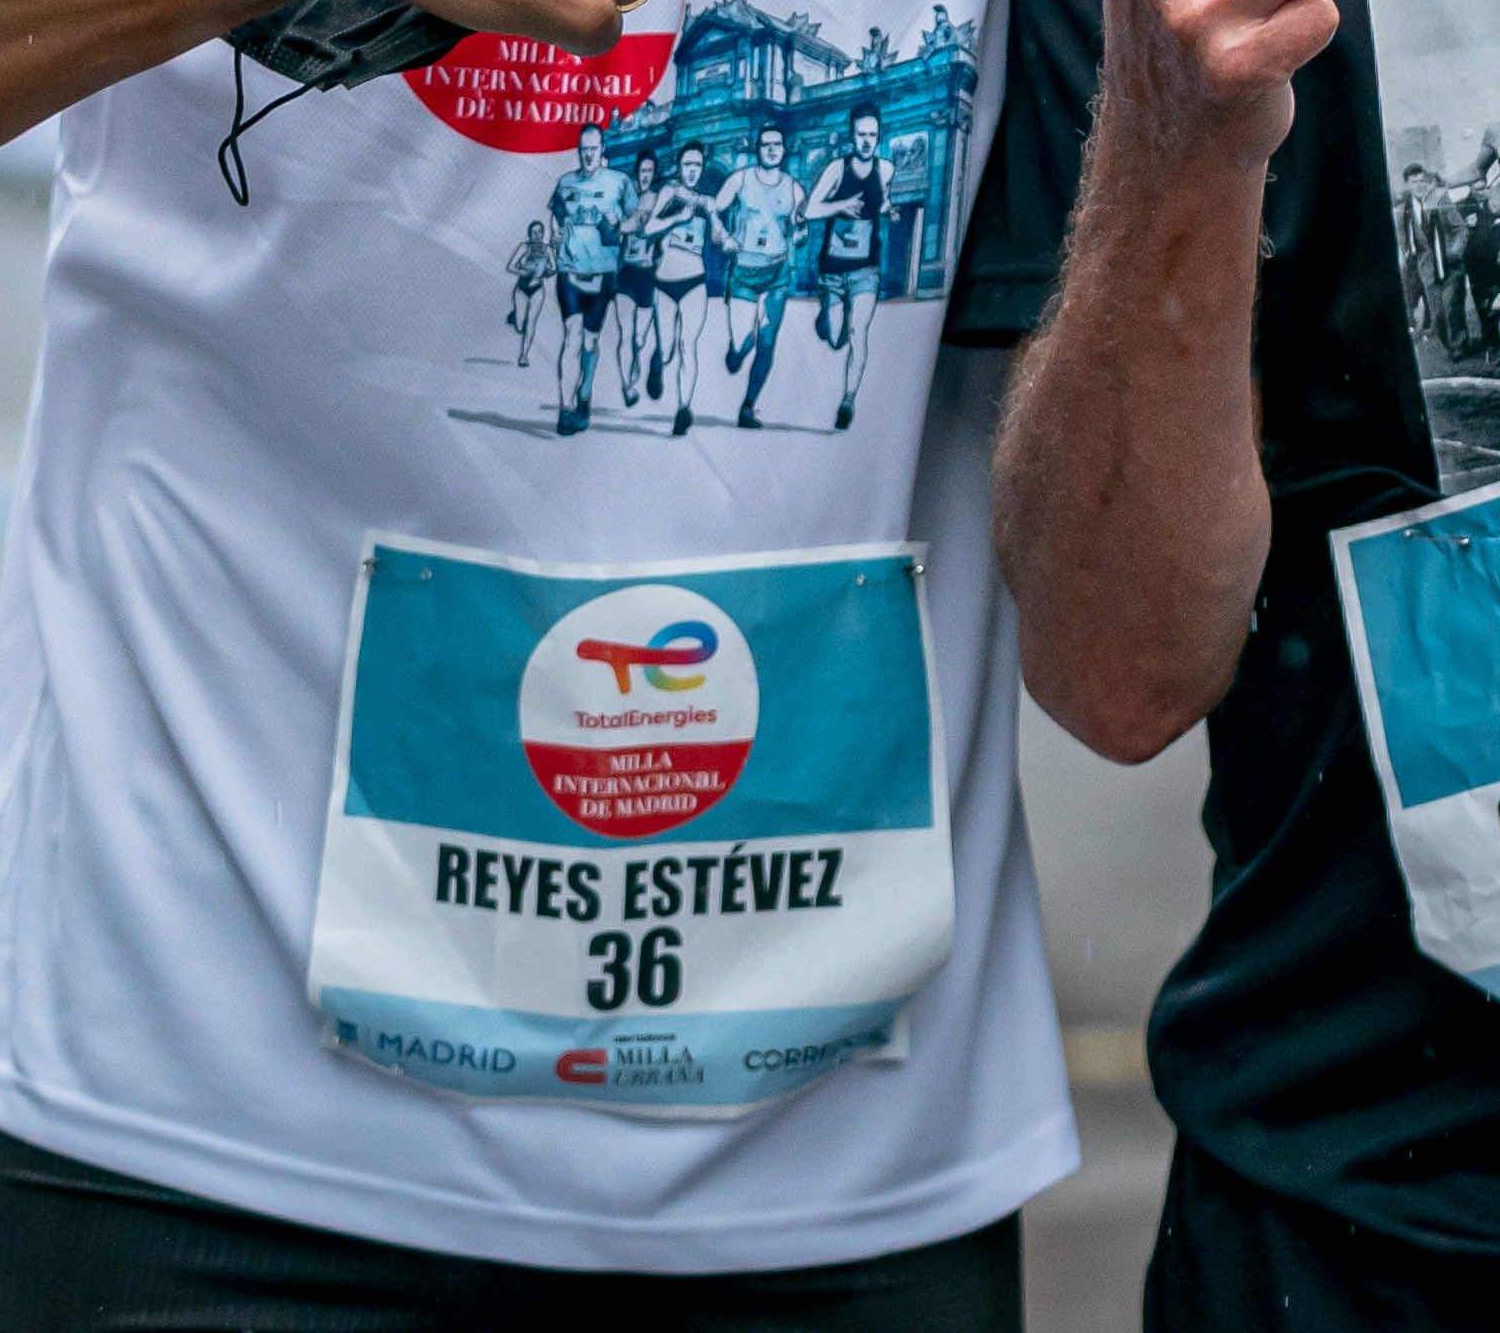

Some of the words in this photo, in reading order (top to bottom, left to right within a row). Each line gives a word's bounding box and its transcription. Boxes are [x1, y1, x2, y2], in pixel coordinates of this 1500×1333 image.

[456, 97, 495, 120] DE
[504, 100, 606, 125] MADRID
[574, 706, 718, 729] TotalEnergies
[610, 751, 673, 773] MILLA
[580, 797, 612, 820] DE
[616, 793, 698, 817] MADRID
[435, 842, 602, 923] REYES
[623, 844, 844, 923] ESTÉVEZ
[586, 927, 685, 1012] 36
[376, 1032, 517, 1074] MADRID
[615, 1046, 694, 1066] MILLA
